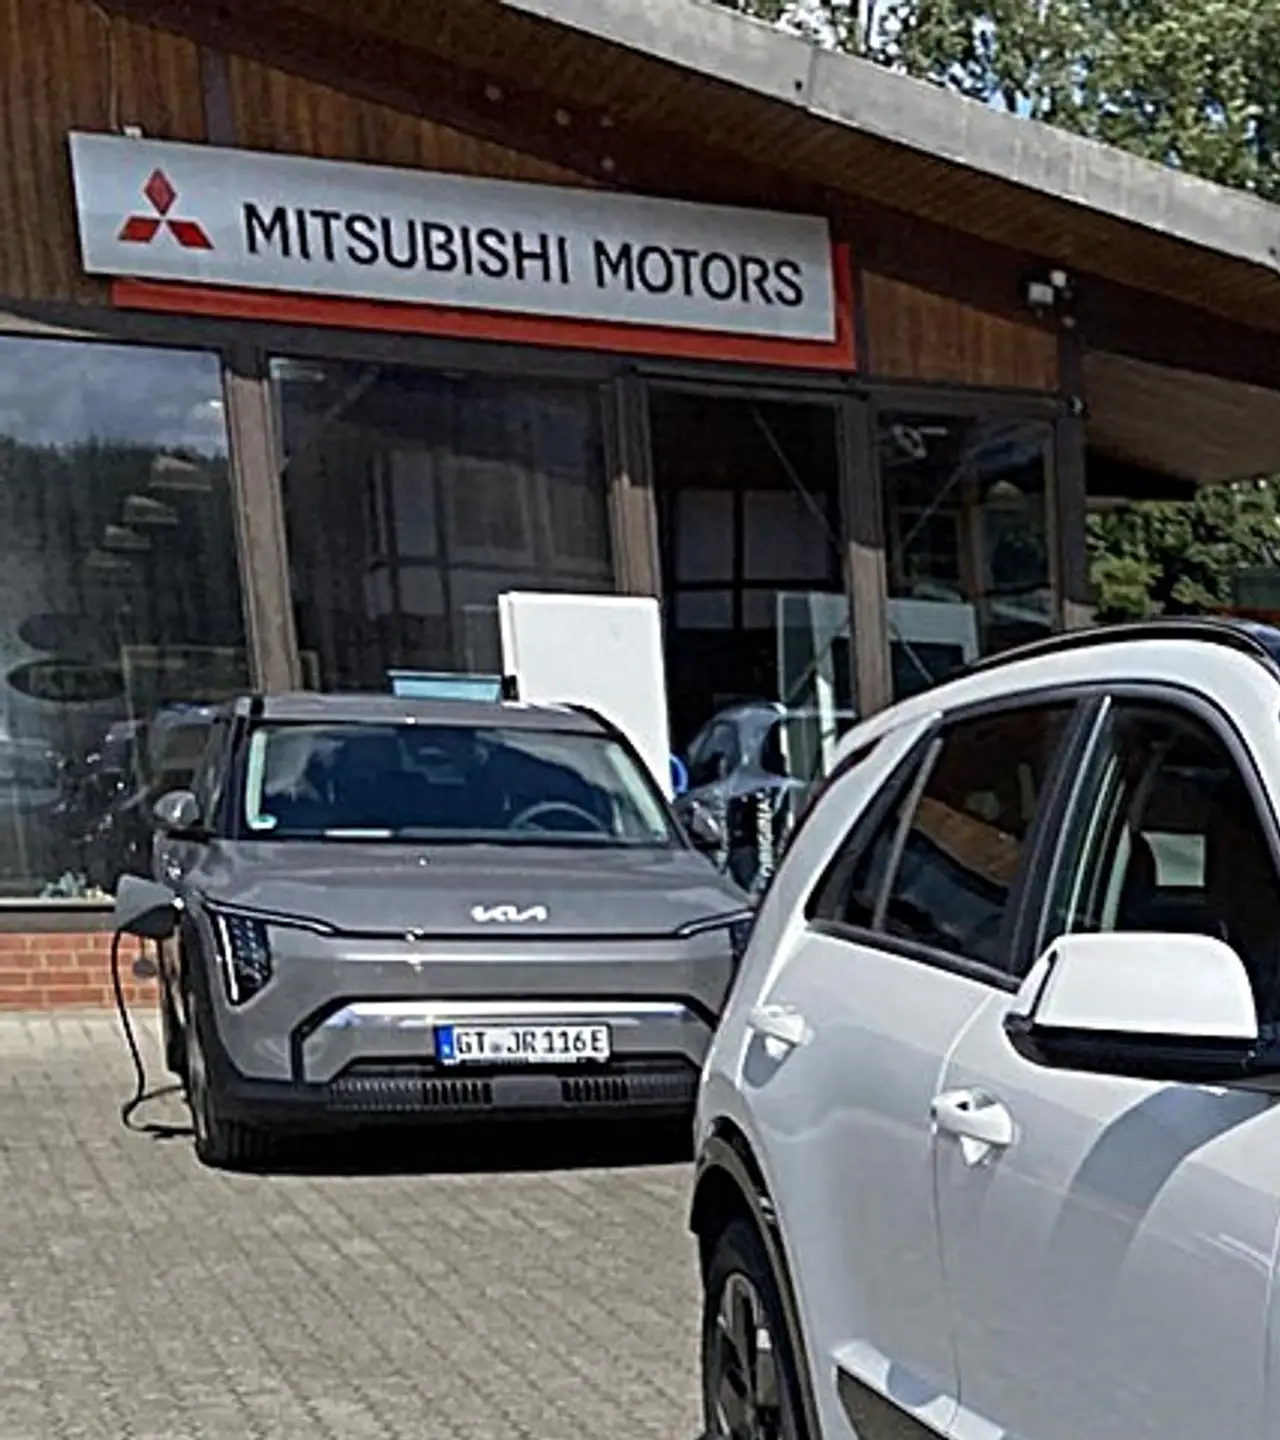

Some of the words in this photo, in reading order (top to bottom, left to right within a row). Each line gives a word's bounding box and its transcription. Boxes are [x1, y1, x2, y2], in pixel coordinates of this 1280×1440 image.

[243, 202, 571, 284] MITSUBISHI
[594, 240, 805, 306] MOTORS
[457, 1031, 487, 1055] GT
